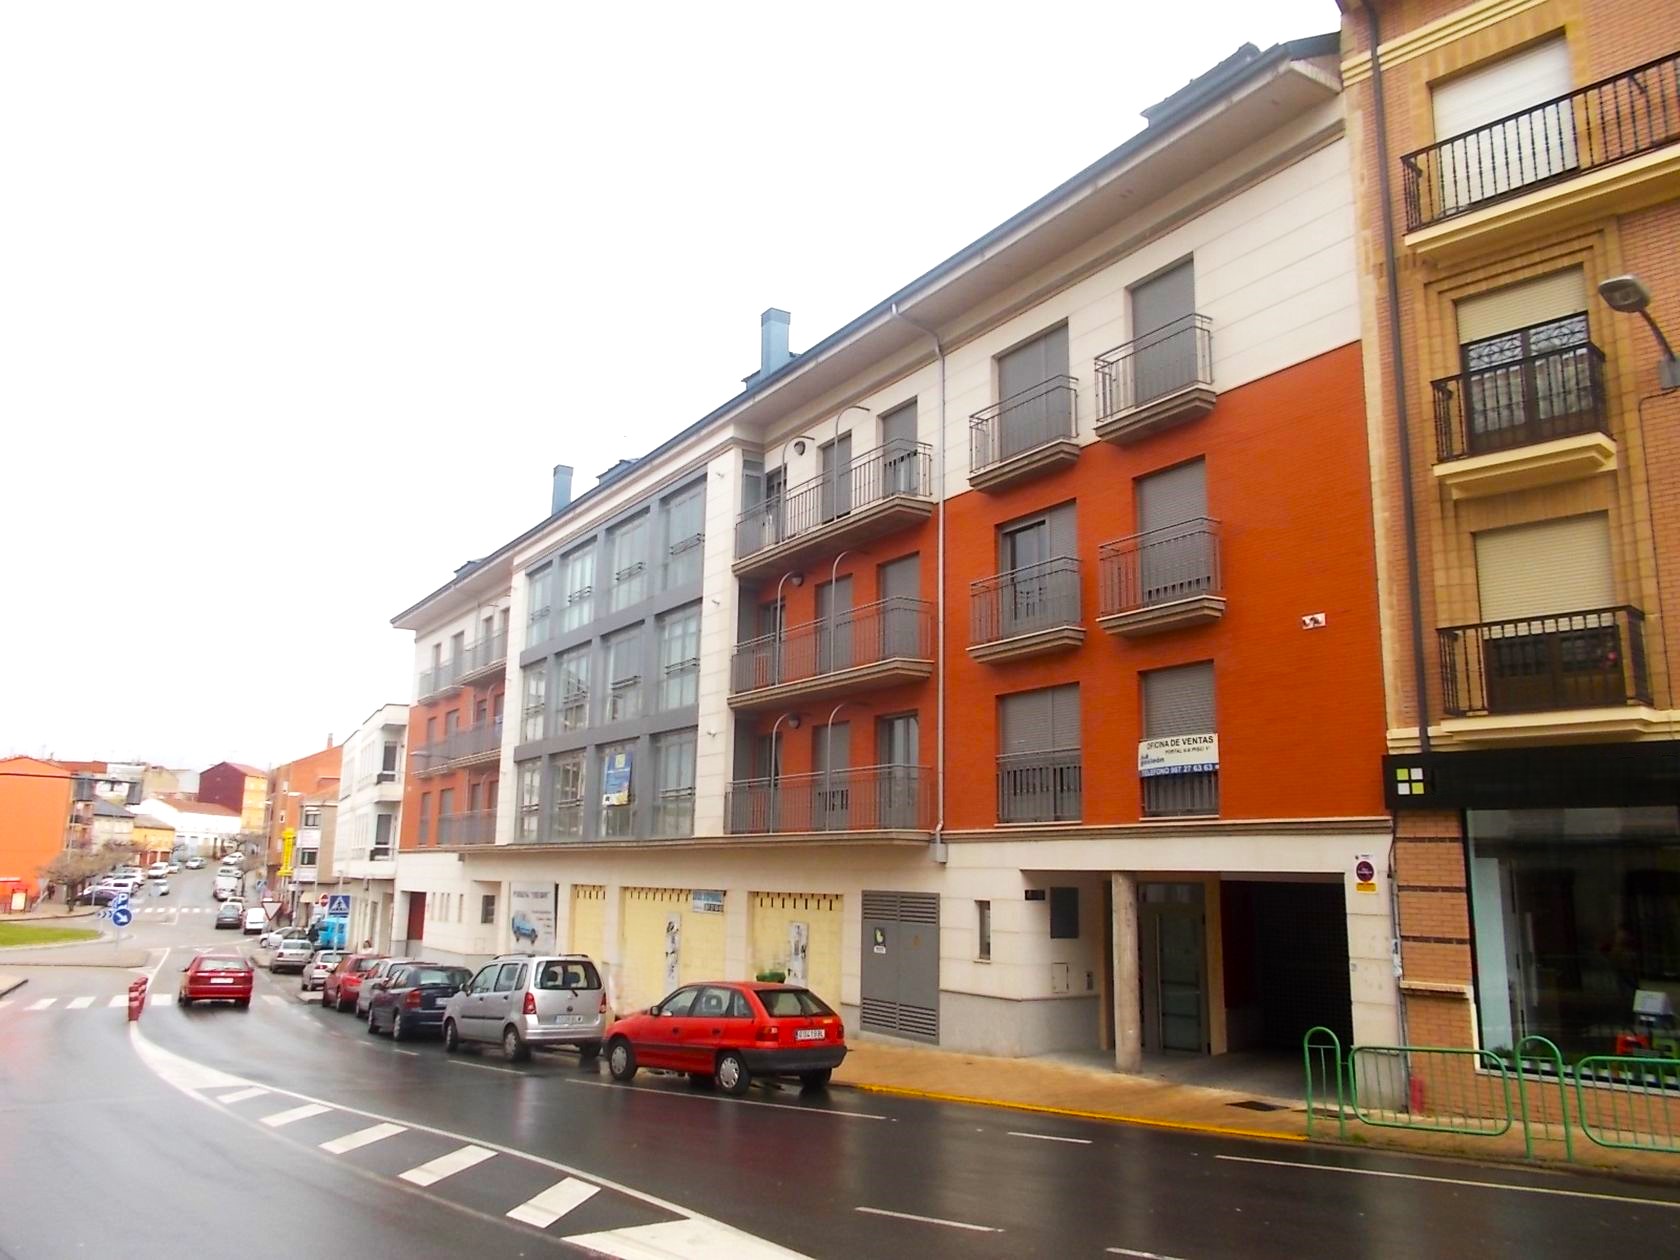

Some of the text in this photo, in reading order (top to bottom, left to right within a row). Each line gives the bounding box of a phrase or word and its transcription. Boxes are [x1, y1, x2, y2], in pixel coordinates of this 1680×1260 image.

[1170, 738, 1181, 747] DE
[1182, 736, 1213, 745] VENTAS
[1183, 765, 1192, 773] 27
